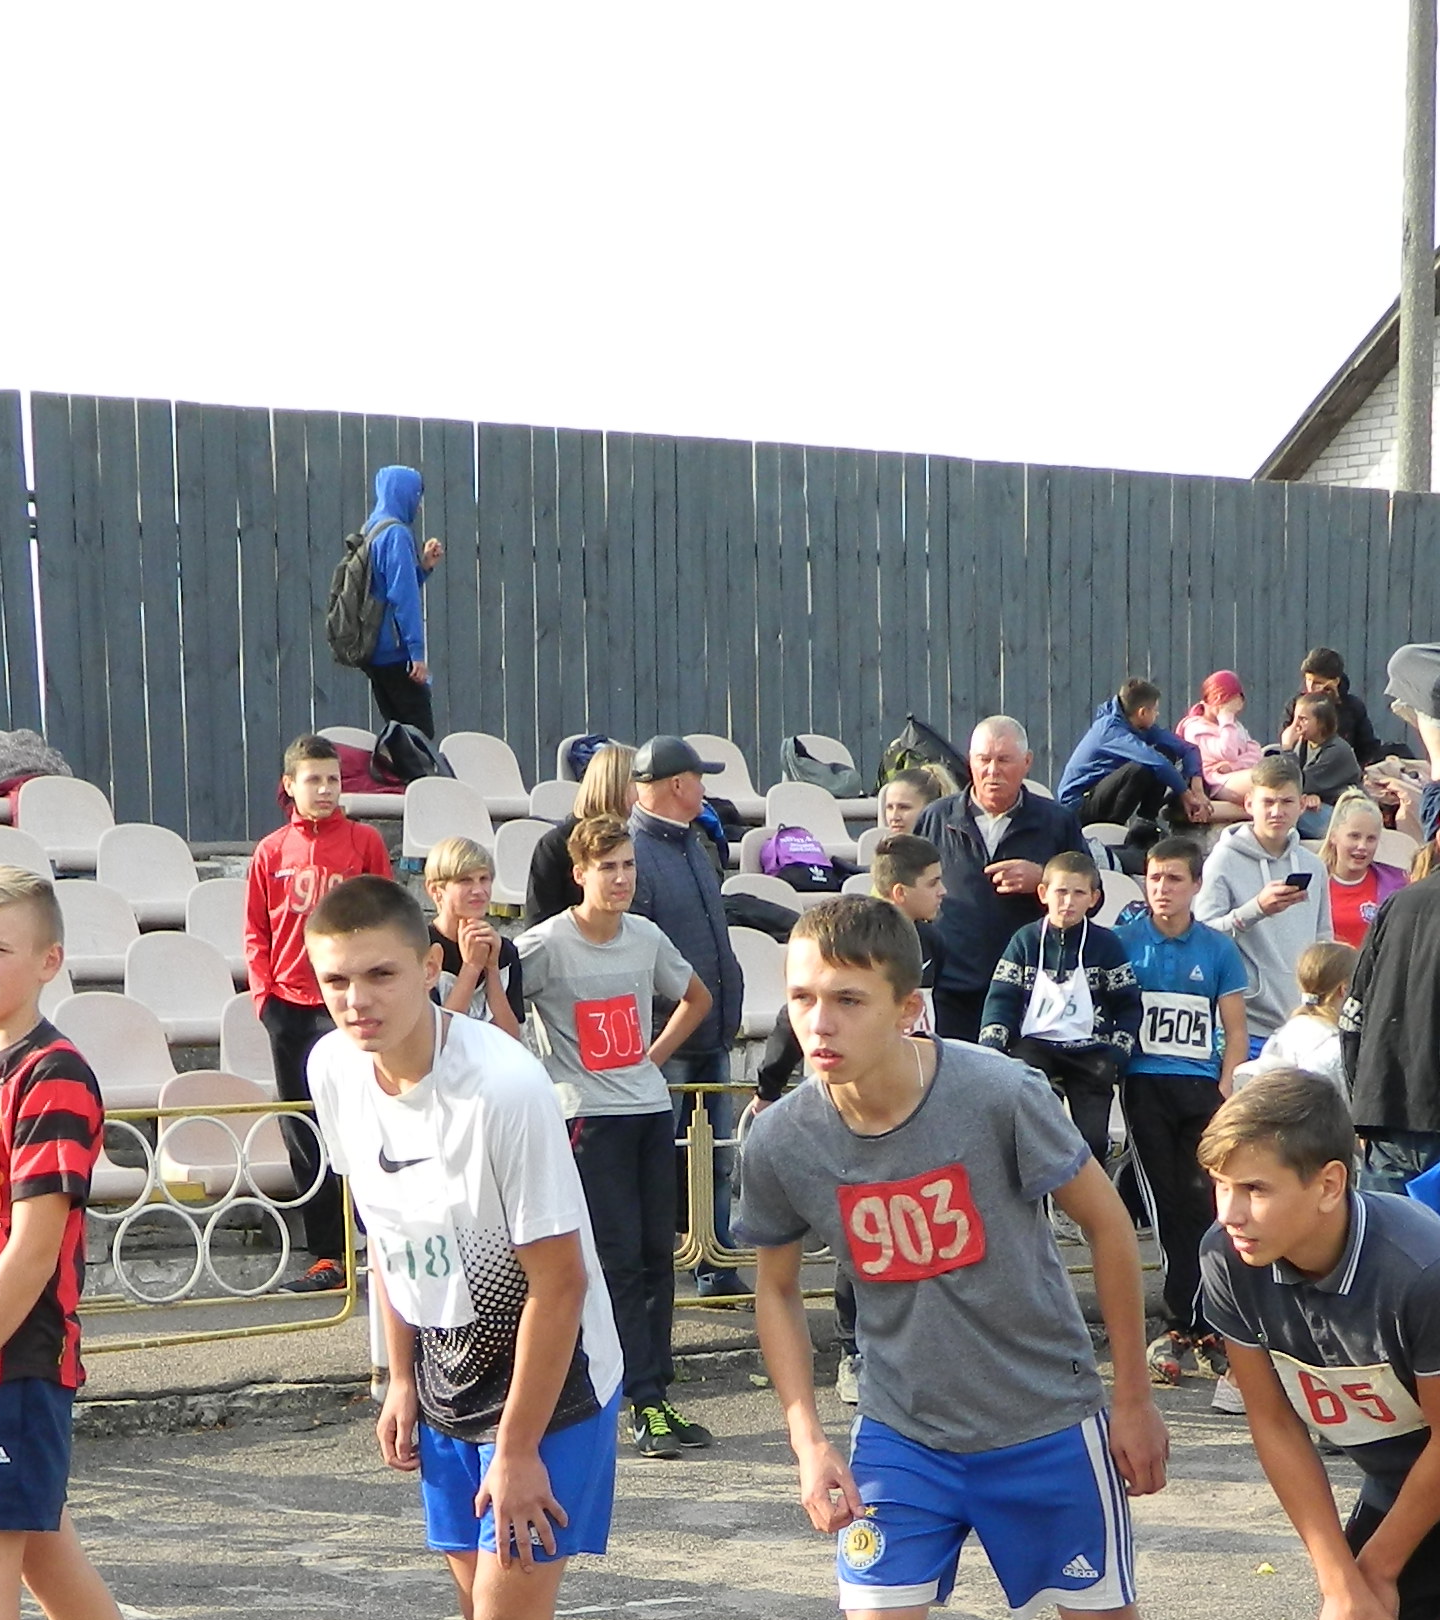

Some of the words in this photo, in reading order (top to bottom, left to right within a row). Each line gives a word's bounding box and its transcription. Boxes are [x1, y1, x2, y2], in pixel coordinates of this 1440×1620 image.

[588, 1006, 643, 1058] 305
[1147, 1005, 1209, 1048] 1505
[851, 1178, 970, 1275] 903
[1298, 1370, 1397, 1424] 65
